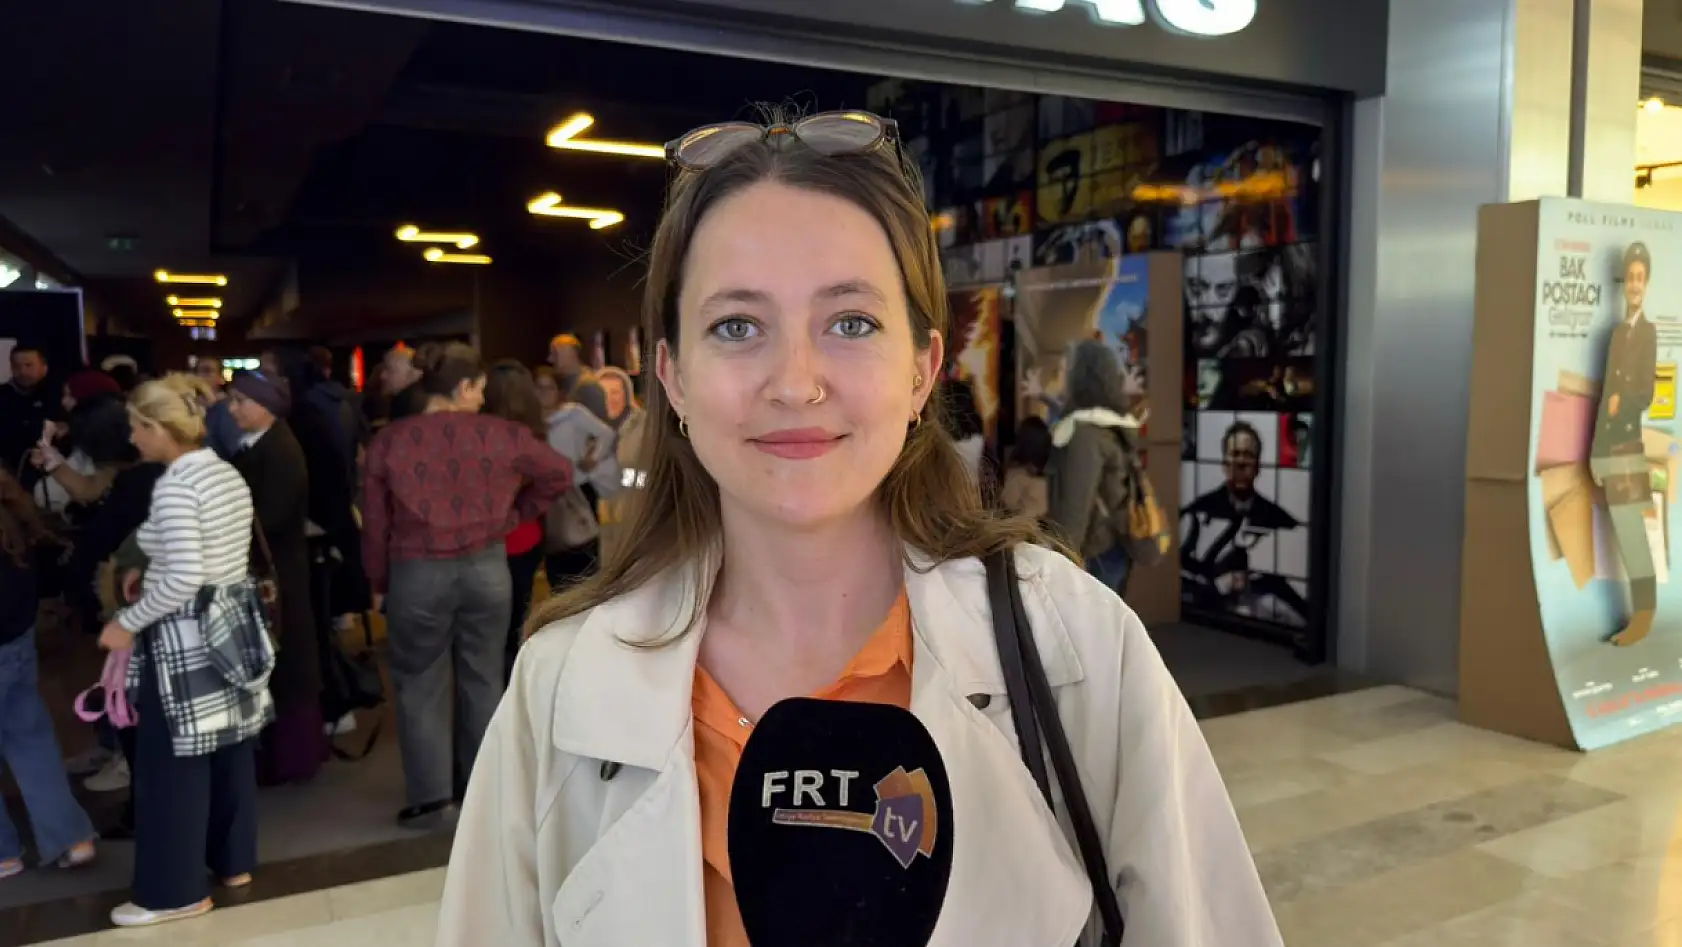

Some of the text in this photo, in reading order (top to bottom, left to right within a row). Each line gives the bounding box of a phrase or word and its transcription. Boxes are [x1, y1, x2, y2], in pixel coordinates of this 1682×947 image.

[1559, 256, 1587, 280] BAK
[761, 769, 860, 808] FRT
[882, 806, 918, 843] tv
